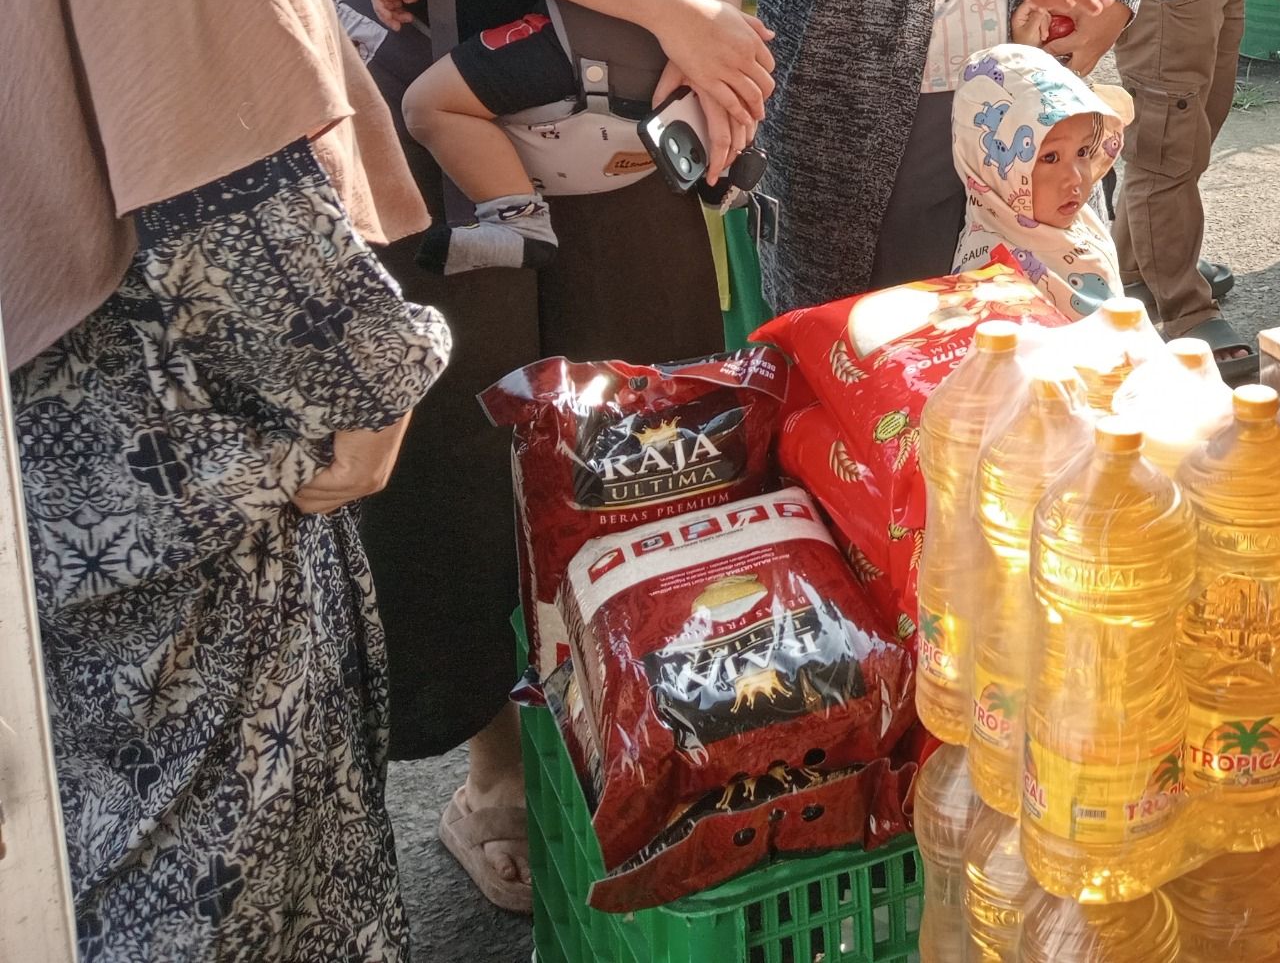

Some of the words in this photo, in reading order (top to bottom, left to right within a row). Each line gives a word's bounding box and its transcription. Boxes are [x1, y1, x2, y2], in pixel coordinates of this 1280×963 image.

[599, 434, 721, 482] RAJA
[611, 468, 717, 500] ULTIMA
[599, 509, 648, 525] BERAS
[657, 491, 729, 517] PREMIUM
